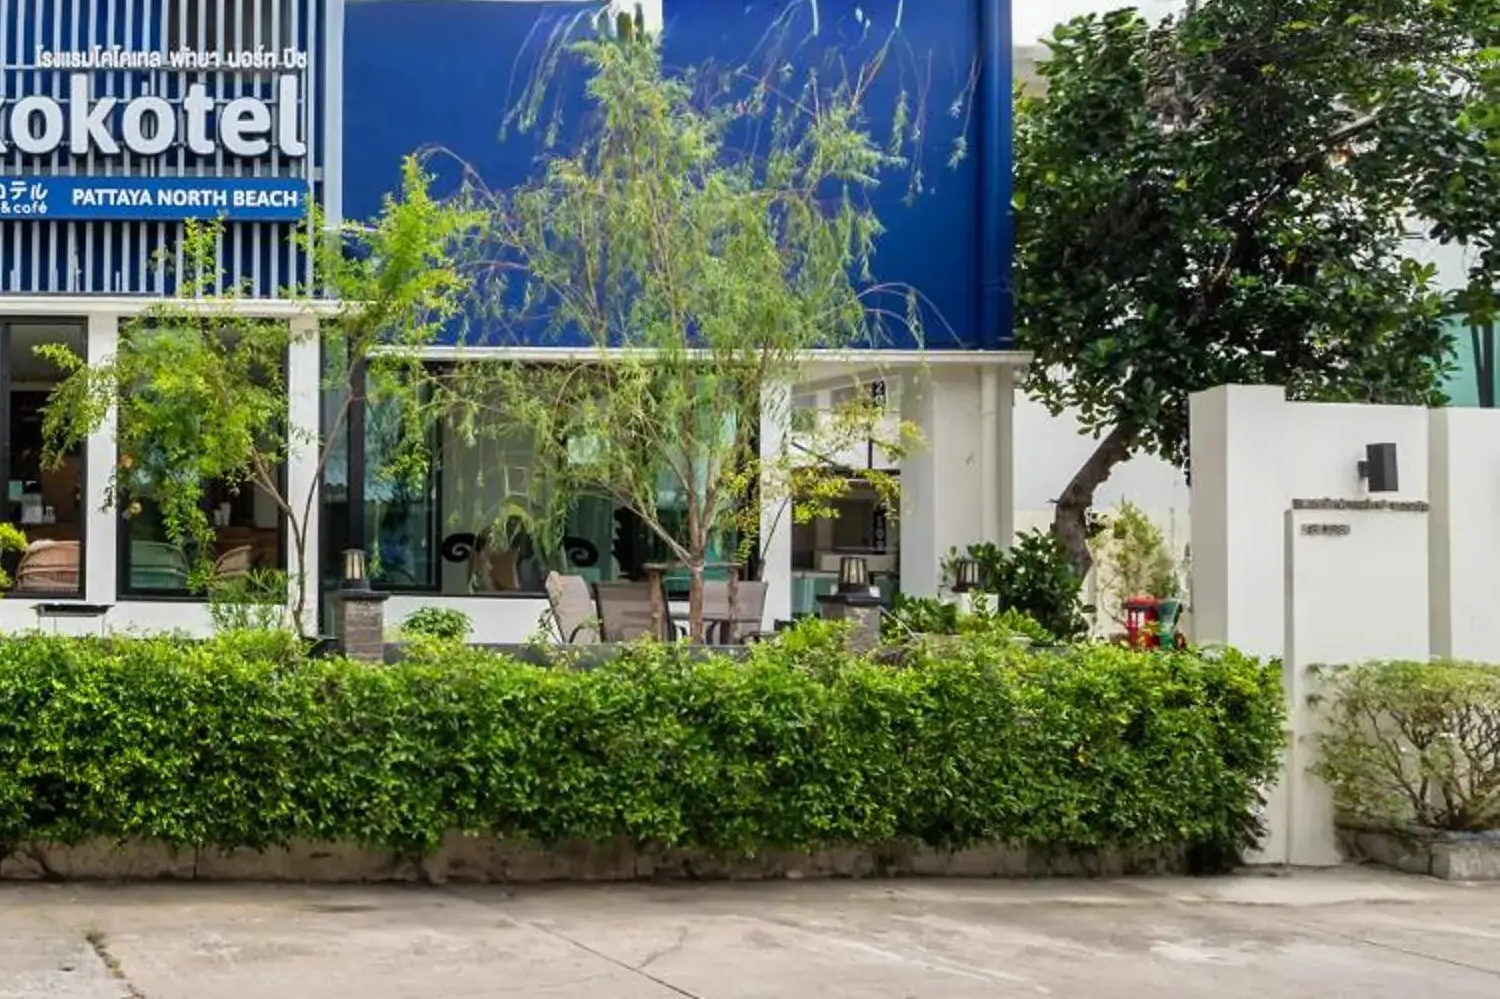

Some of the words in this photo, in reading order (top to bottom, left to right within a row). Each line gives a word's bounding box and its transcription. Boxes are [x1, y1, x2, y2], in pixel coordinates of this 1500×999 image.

[72, 188, 151, 206] PATTAYA
[157, 188, 227, 207] NORTH
[233, 189, 298, 208] BEACH
